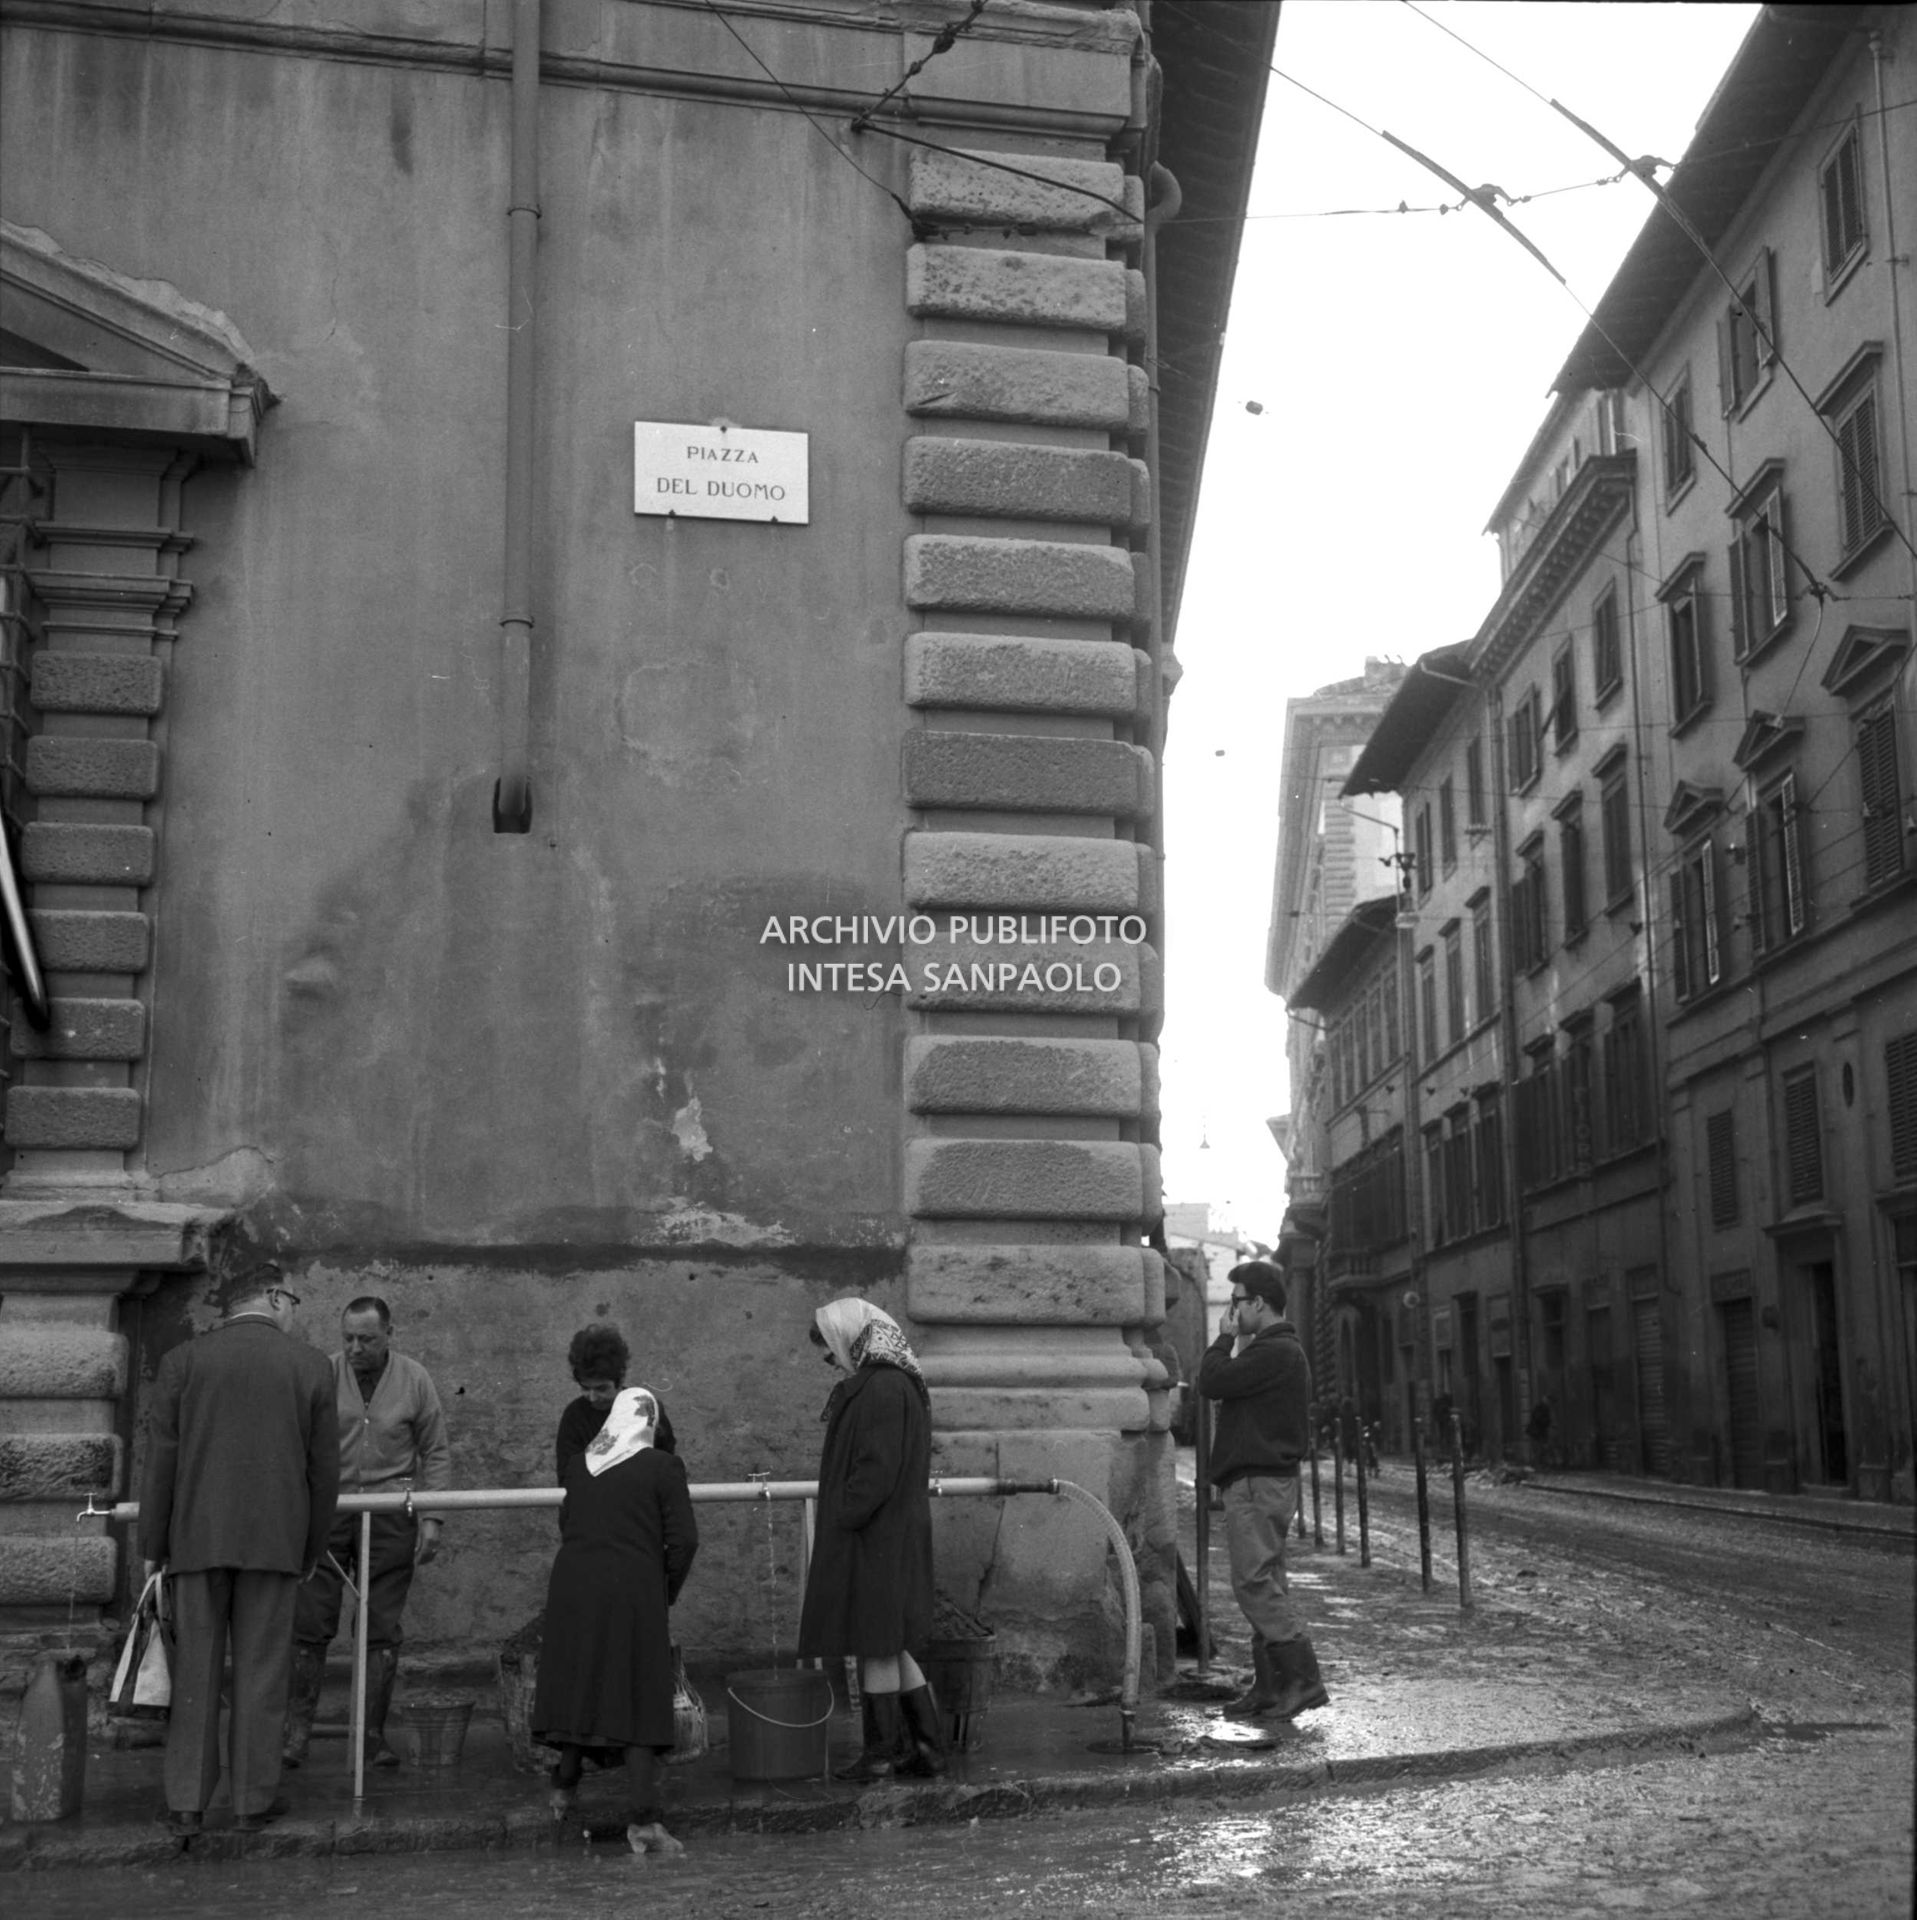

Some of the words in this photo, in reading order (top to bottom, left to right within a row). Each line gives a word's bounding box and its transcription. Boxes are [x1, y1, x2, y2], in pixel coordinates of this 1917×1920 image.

[686, 445, 759, 464] PIAZZA
[656, 477, 698, 495] DEL
[706, 480, 786, 501] DUOMO
